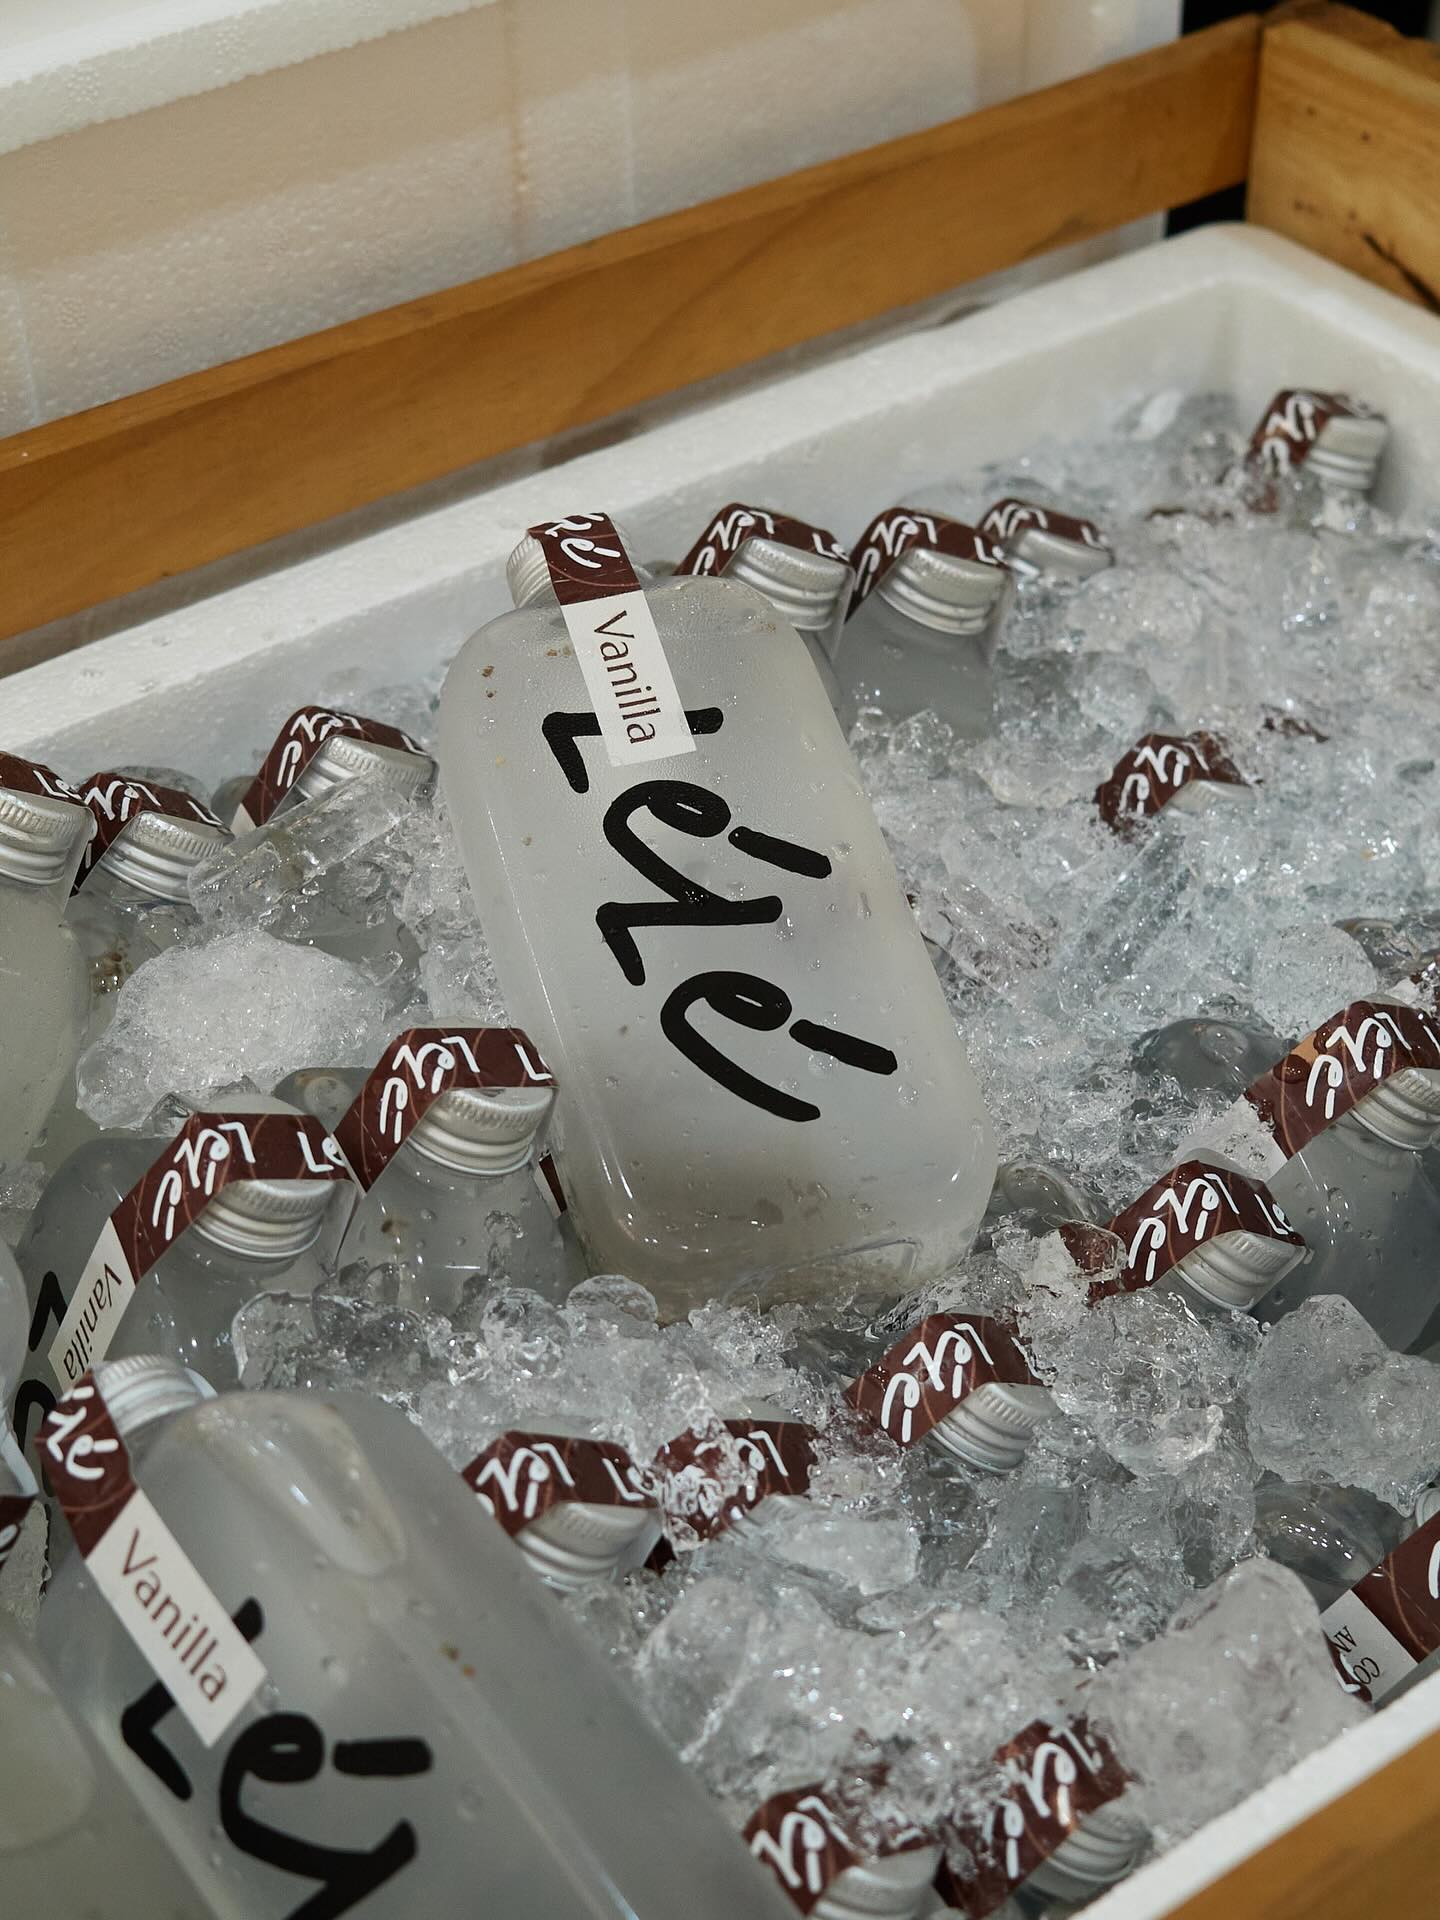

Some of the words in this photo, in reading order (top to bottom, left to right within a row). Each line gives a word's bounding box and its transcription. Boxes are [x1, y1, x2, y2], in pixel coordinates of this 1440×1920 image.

[593, 610, 662, 745] Vanilla
[62, 1263, 123, 1381] Vanilla
[120, 1528, 228, 1703] Vanilla
[1333, 1624, 1358, 1654] AN
[1353, 1656, 1380, 1685] CO
